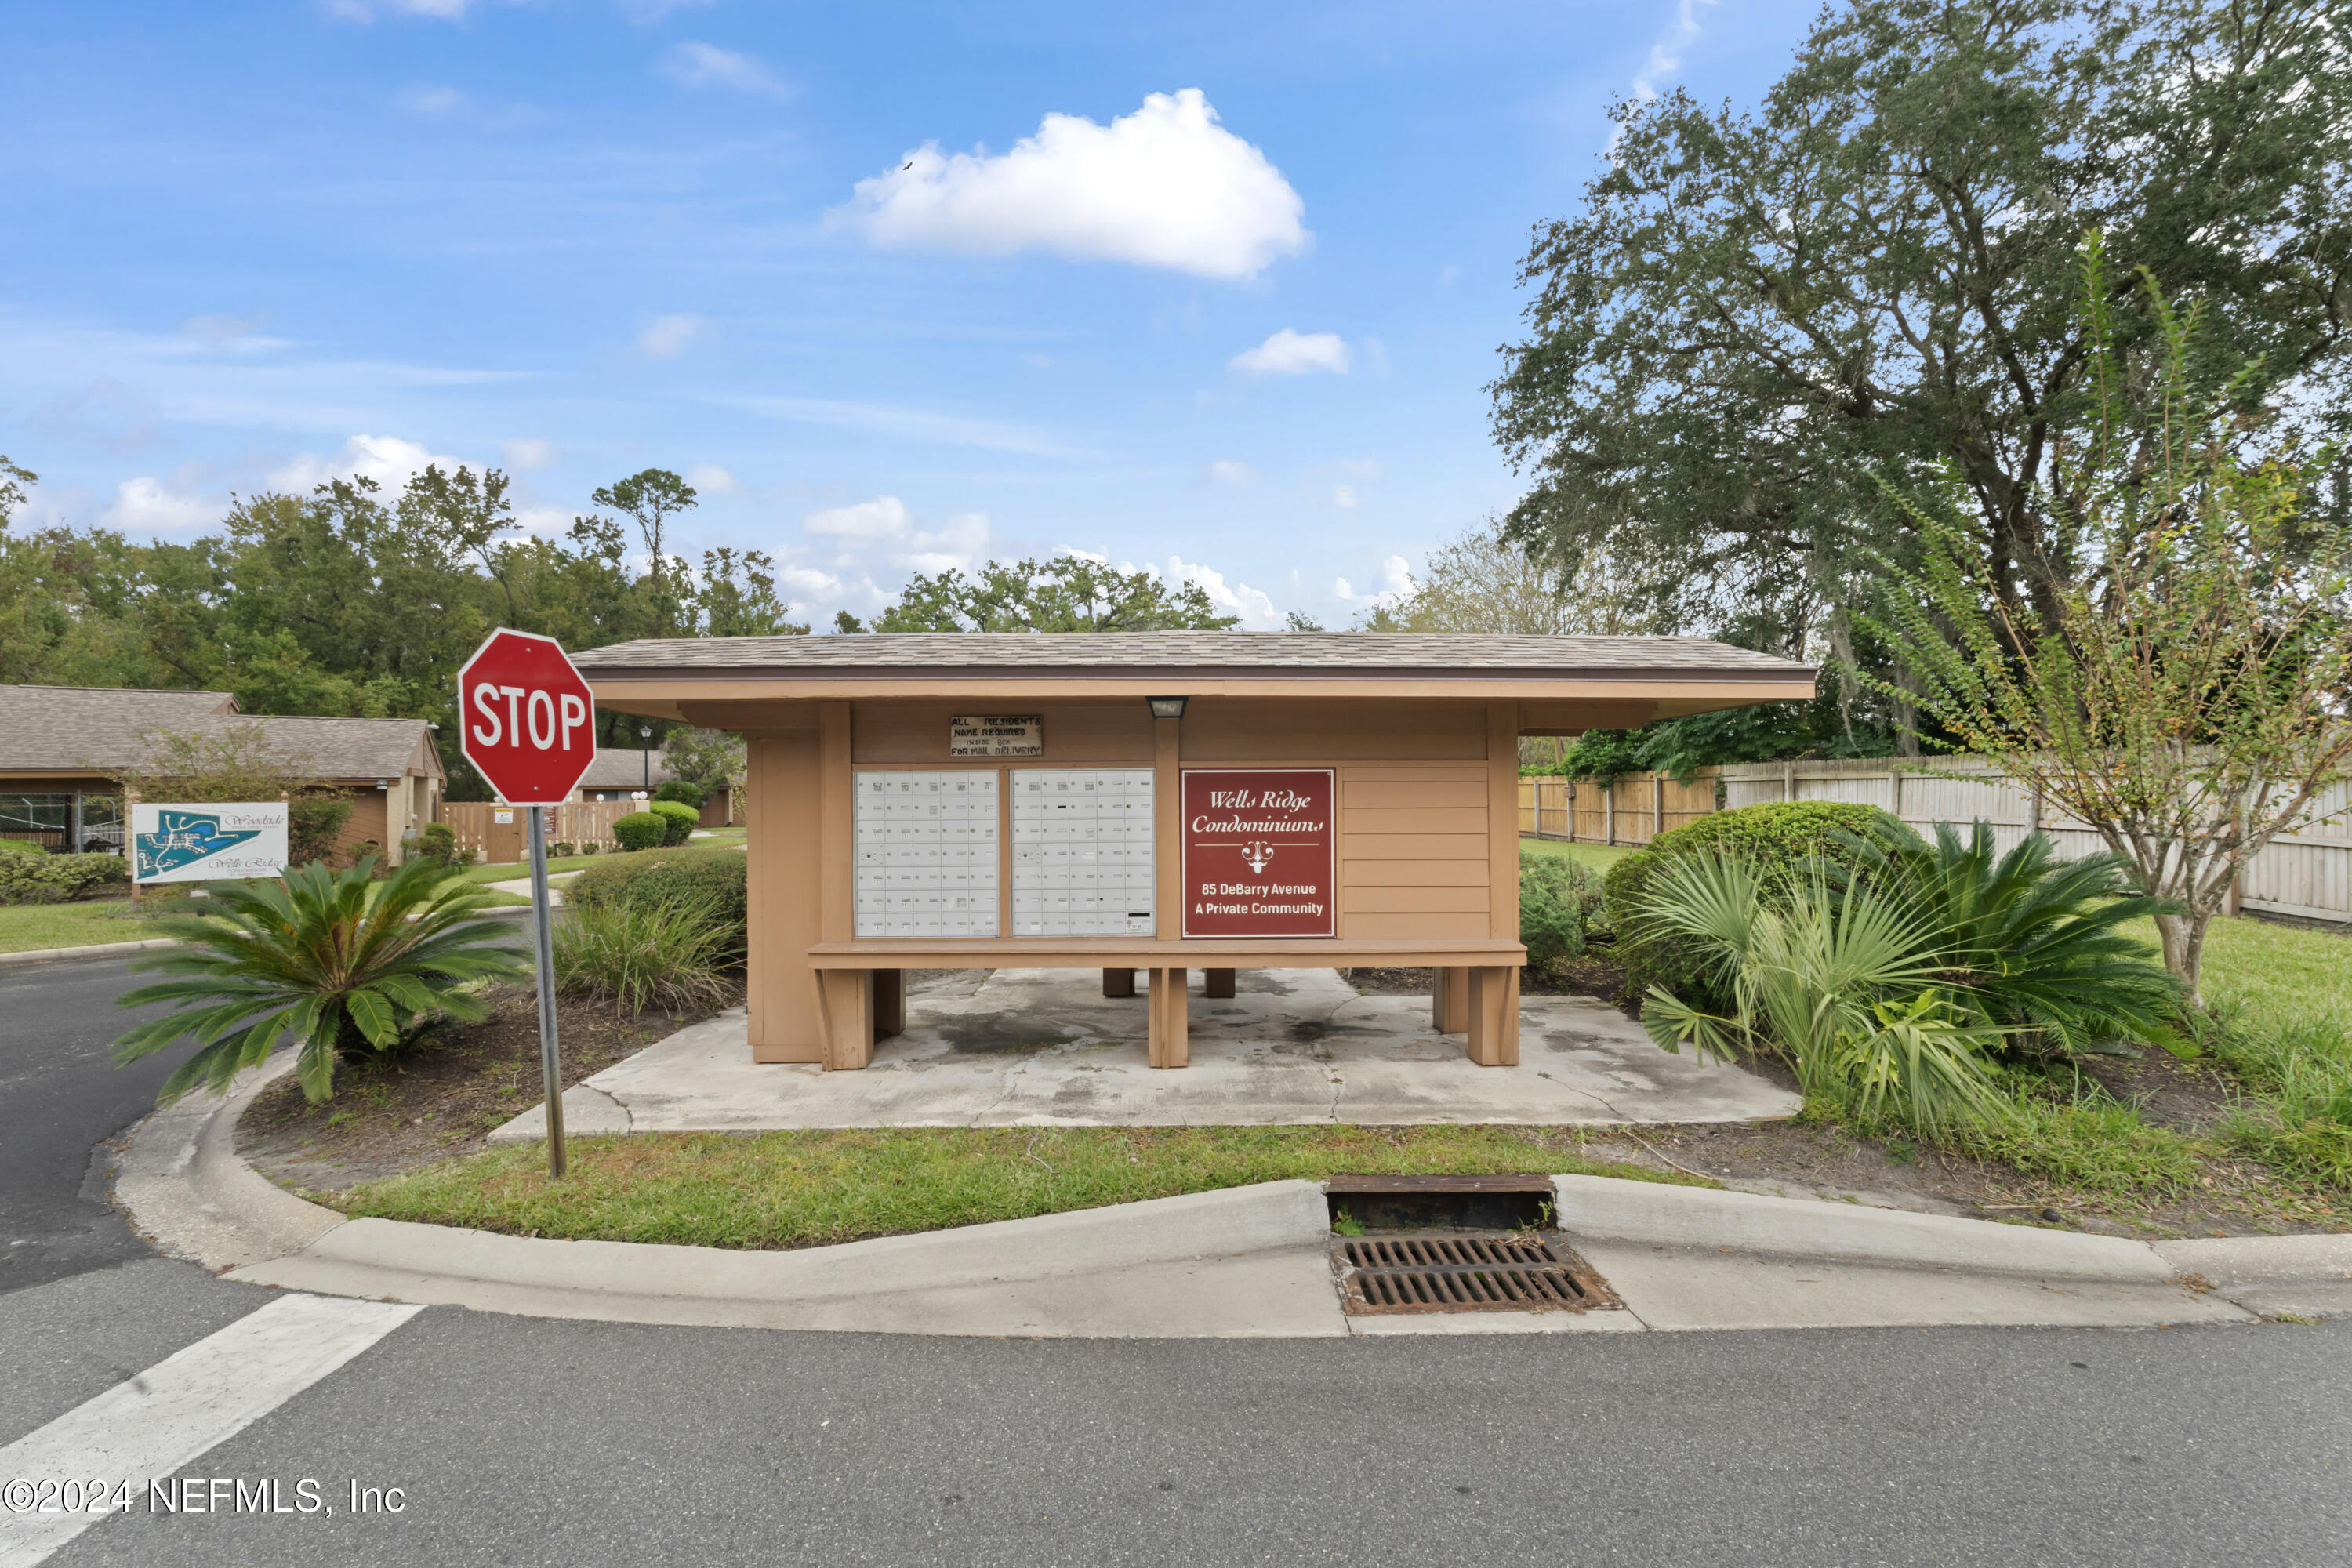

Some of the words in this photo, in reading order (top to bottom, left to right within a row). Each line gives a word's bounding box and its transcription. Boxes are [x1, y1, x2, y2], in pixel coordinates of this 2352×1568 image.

[473, 682, 586, 751] STOP
[951, 717, 970, 726] ALL
[984, 717, 1041, 726] RESIDENTS
[954, 728, 978, 737] NAME
[982, 728, 1026, 736] REQUIRED
[971, 746, 990, 755] MAIL
[994, 746, 1040, 755] DELIVERY
[1210, 789, 1256, 808] Wells
[1260, 789, 1312, 813] Ridge
[1192, 814, 1324, 833] Condominiums
[208, 858, 243, 869] Wells
[1201, 884, 1217, 895] 85
[1220, 883, 1269, 898] DeBarry
[1271, 883, 1316, 895] Avenue
[1195, 903, 1203, 914] A
[1206, 902, 1248, 914] Private
[1251, 902, 1323, 916] Community
